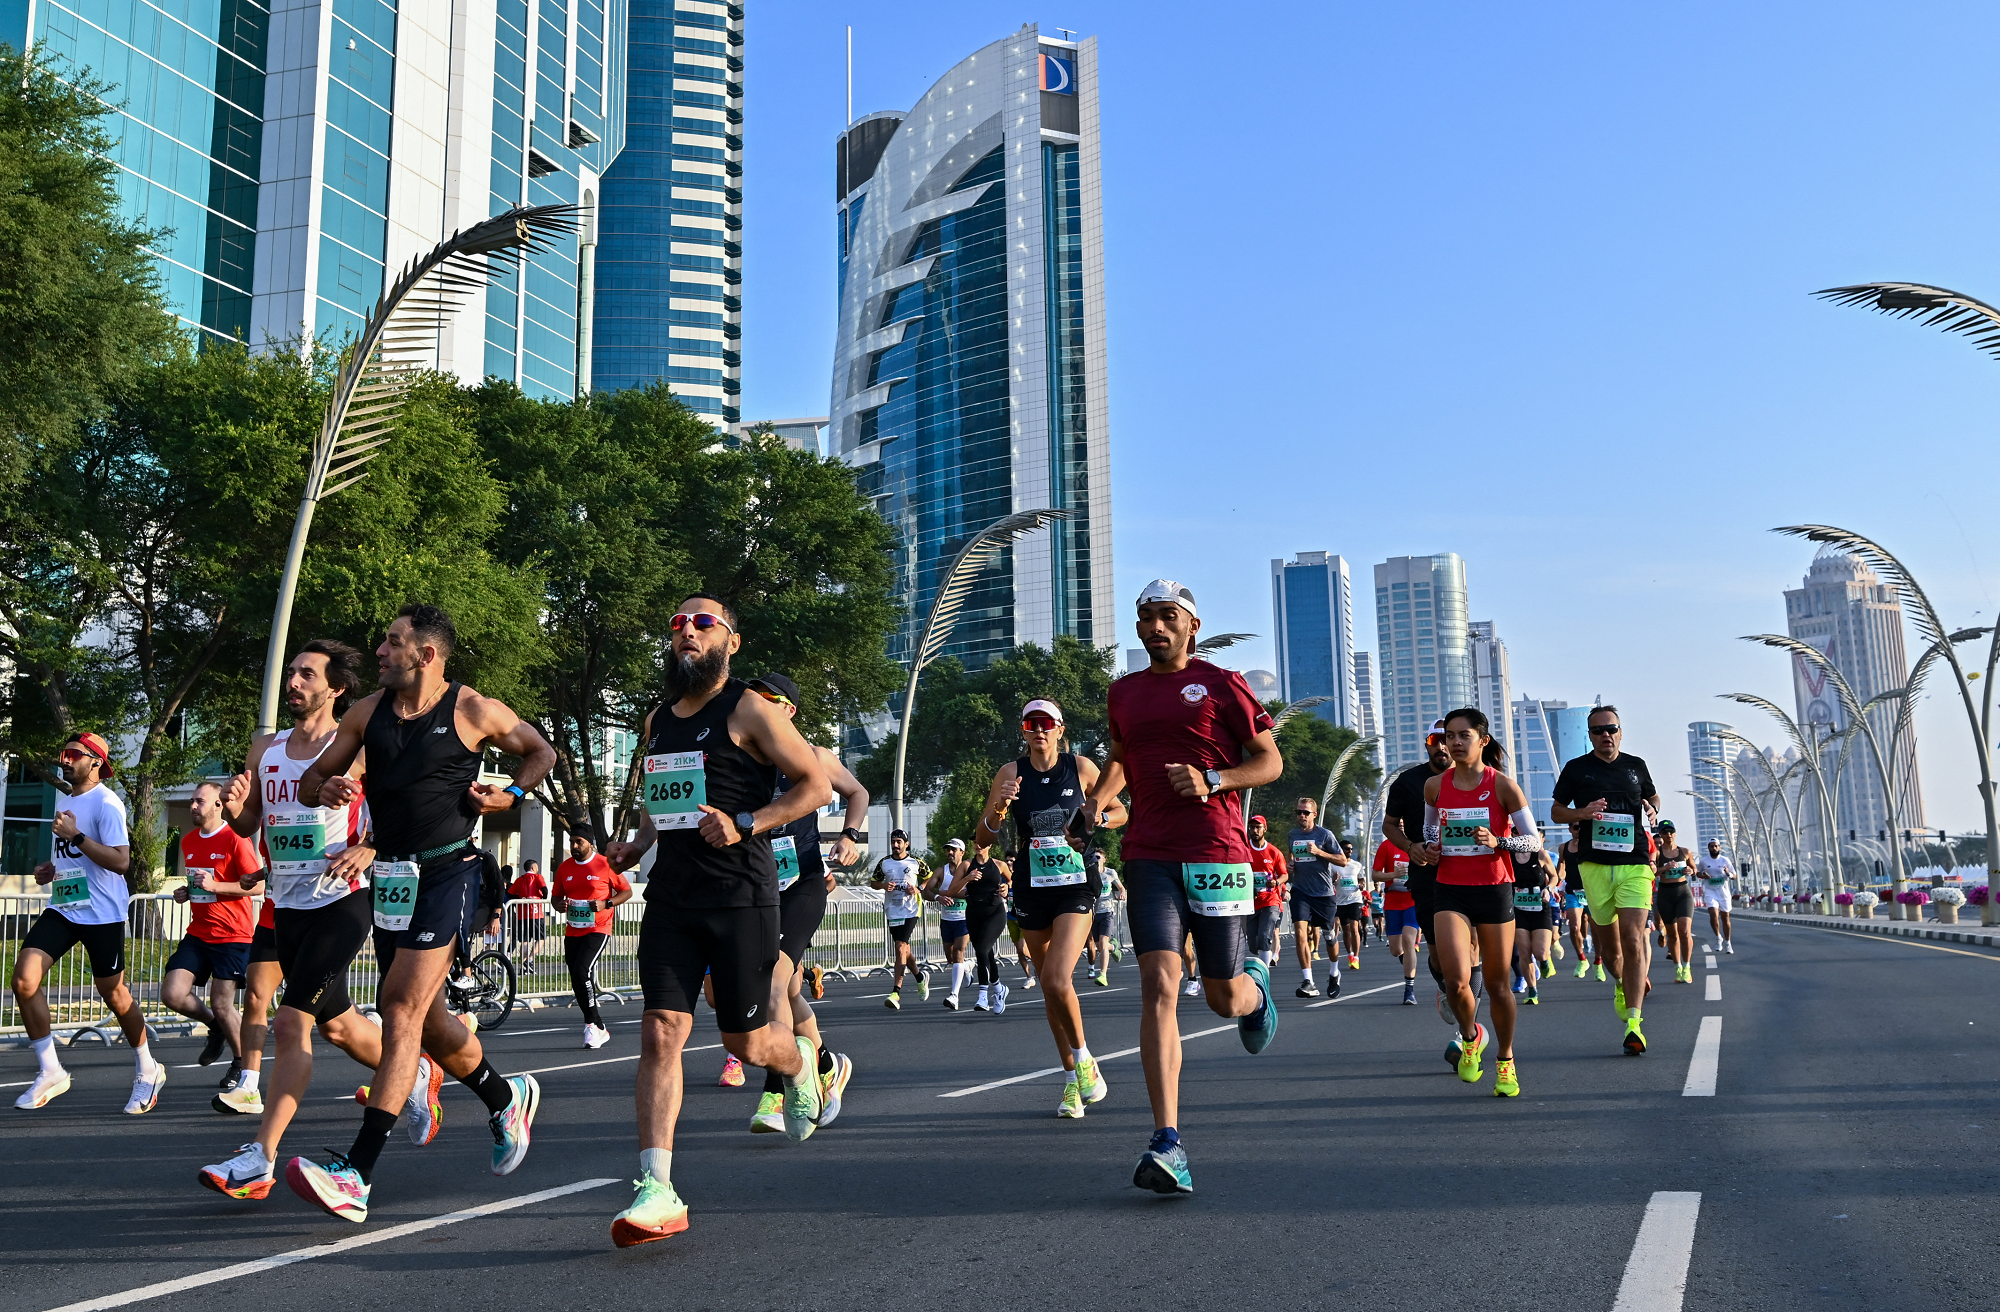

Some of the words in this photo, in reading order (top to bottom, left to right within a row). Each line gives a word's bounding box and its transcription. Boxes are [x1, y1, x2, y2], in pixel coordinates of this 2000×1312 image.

[674, 757, 683, 766] 21
[683, 756, 696, 765] KM
[266, 779, 300, 805] QAT
[650, 780, 695, 802] 2689
[296, 814, 304, 822] 21
[305, 813, 318, 821] KM
[1444, 826, 1480, 838] 238
[1598, 826, 1629, 837] 2418
[272, 834, 315, 850] 1945
[1039, 853, 1074, 868] 1591
[1193, 872, 1247, 891] 3245
[57, 883, 80, 897] 1721
[378, 886, 411, 904] 362
[569, 909, 591, 918] 2056
